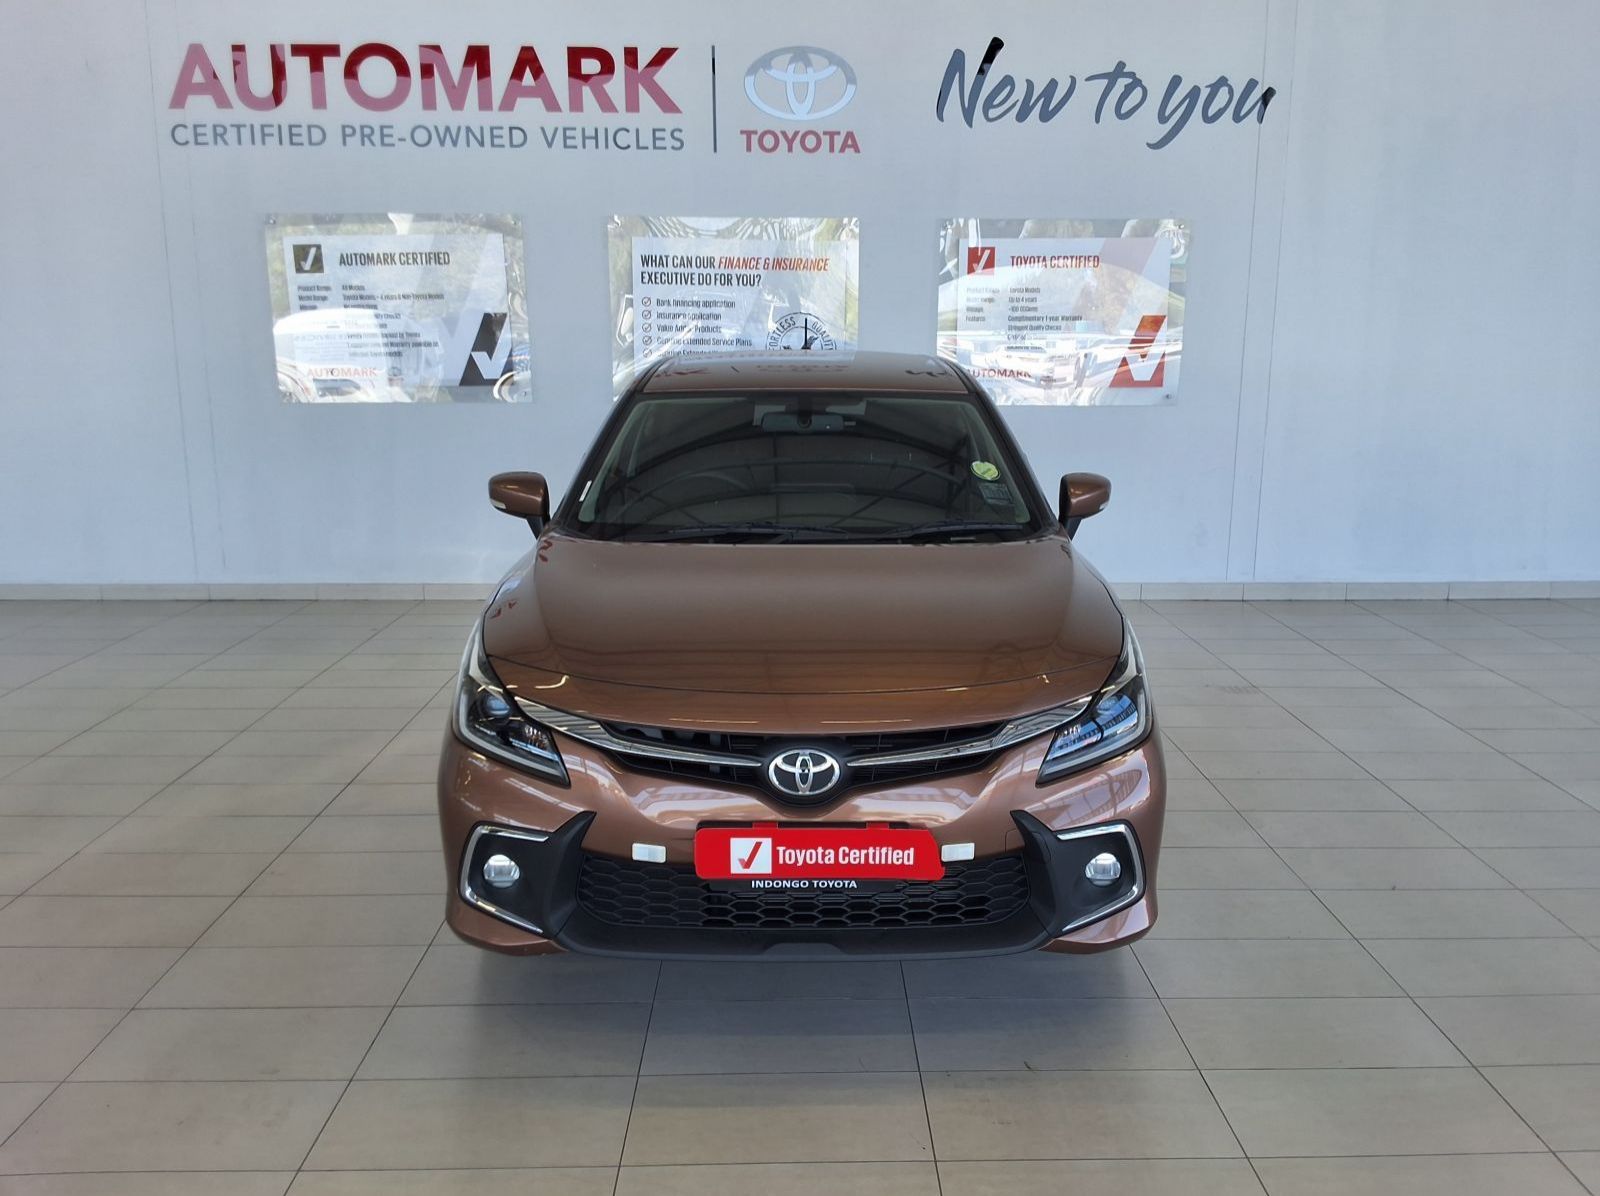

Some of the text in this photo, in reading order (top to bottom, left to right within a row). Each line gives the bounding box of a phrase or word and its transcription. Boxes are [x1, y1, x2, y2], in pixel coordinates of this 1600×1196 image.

[168, 43, 683, 114] AUTOMARK
[936, 37, 1277, 150] New to you
[170, 123, 685, 151] CERTIFIED PRE-OWNED VEHICLES
[740, 130, 861, 154] TOYOTA
[339, 251, 451, 266] AUTOMARK CERTIFIED
[640, 254, 830, 271] WHAT CAN OUR FINANCE & INSURANCE
[1010, 255, 1100, 269] TOYOTA CERTIFIED
[640, 271, 762, 287] EXECUTIVE DO FOR YOU?
[656, 298, 736, 309] Bank financing application
[656, 324, 674, 332] Value
[695, 324, 722, 333] Products
[683, 337, 711, 346] Extended
[712, 338, 735, 346] Service
[735, 337, 753, 347] Plans
[307, 367, 377, 377] AUTOMARK
[776, 846, 915, 866] Toyota Certified
[751, 880, 858, 889] INDONGO TOYOTA
